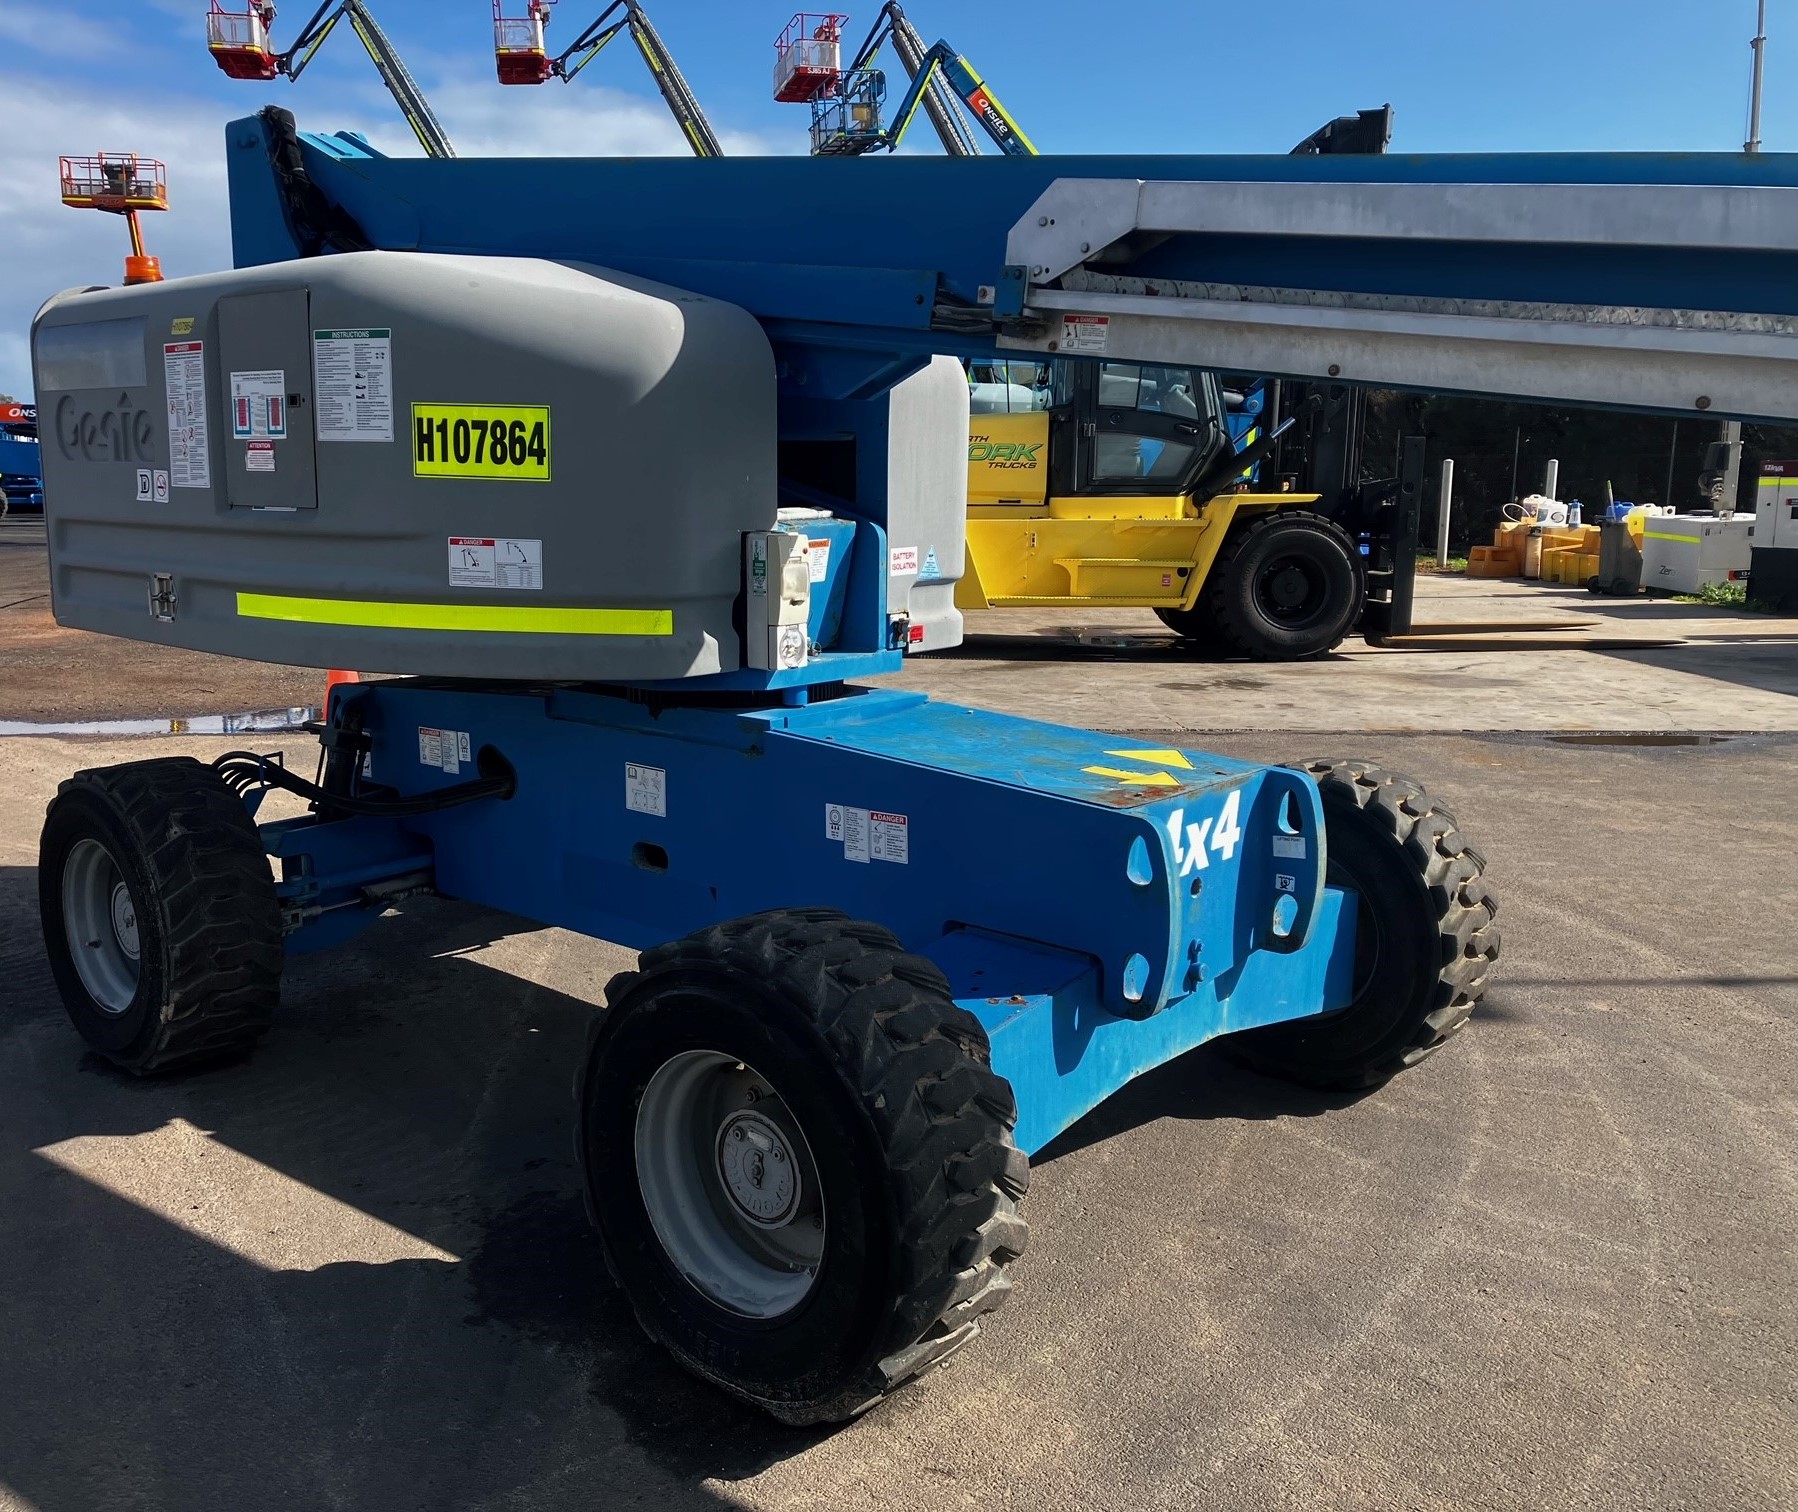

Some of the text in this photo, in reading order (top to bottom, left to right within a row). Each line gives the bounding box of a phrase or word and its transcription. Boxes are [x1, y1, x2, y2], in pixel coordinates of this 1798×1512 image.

[8, 407, 37, 417] ONS
[56, 390, 155, 462] Genie
[416, 417, 547, 466] H107864
[968, 443, 1044, 461] ORK
[988, 461, 1038, 469] TRUCKS
[893, 551, 916, 561] BATTERY
[892, 561, 916, 571] ISOLATION
[877, 814, 904, 824] DANGER
